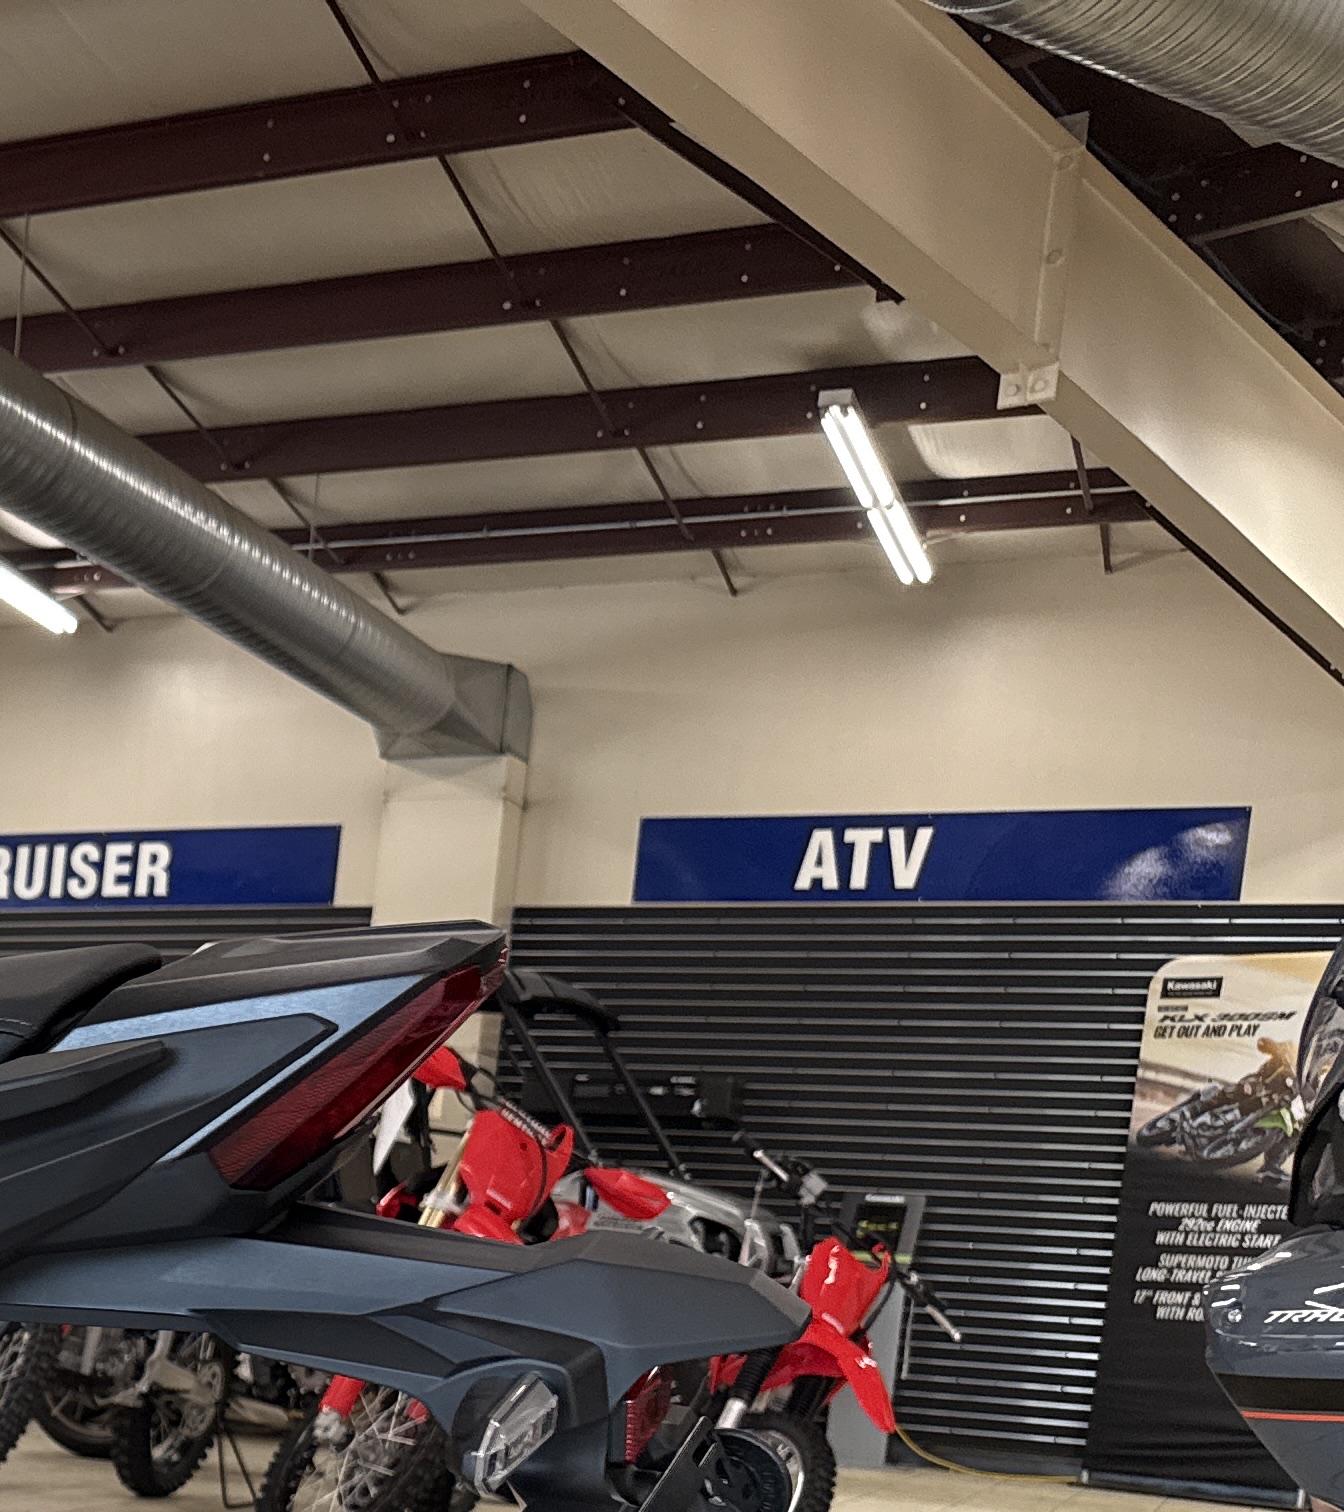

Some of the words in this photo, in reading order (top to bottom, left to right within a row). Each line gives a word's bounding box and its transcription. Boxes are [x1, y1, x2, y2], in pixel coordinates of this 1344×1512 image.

[793, 825, 934, 891] ATV
[1153, 1025, 1176, 1039] GET
[1176, 1025, 1202, 1039] OUT
[1201, 1024, 1228, 1038] AND
[1228, 1023, 1261, 1038] PLAY
[1148, 1202, 1209, 1218] POWERFUL
[1212, 1203, 1290, 1220] FUEL-INJECTE
[1216, 1218, 1262, 1233] ENGINE
[1155, 1230, 1186, 1246] WITH
[1185, 1231, 1242, 1248] ELECTRIC
[1158, 1252, 1229, 1270] SUPERMOTO
[1135, 1266, 1212, 1284] LONG-TRAVEL
[1152, 1290, 1192, 1306] FRONT
[1155, 1306, 1186, 1321] WITH
